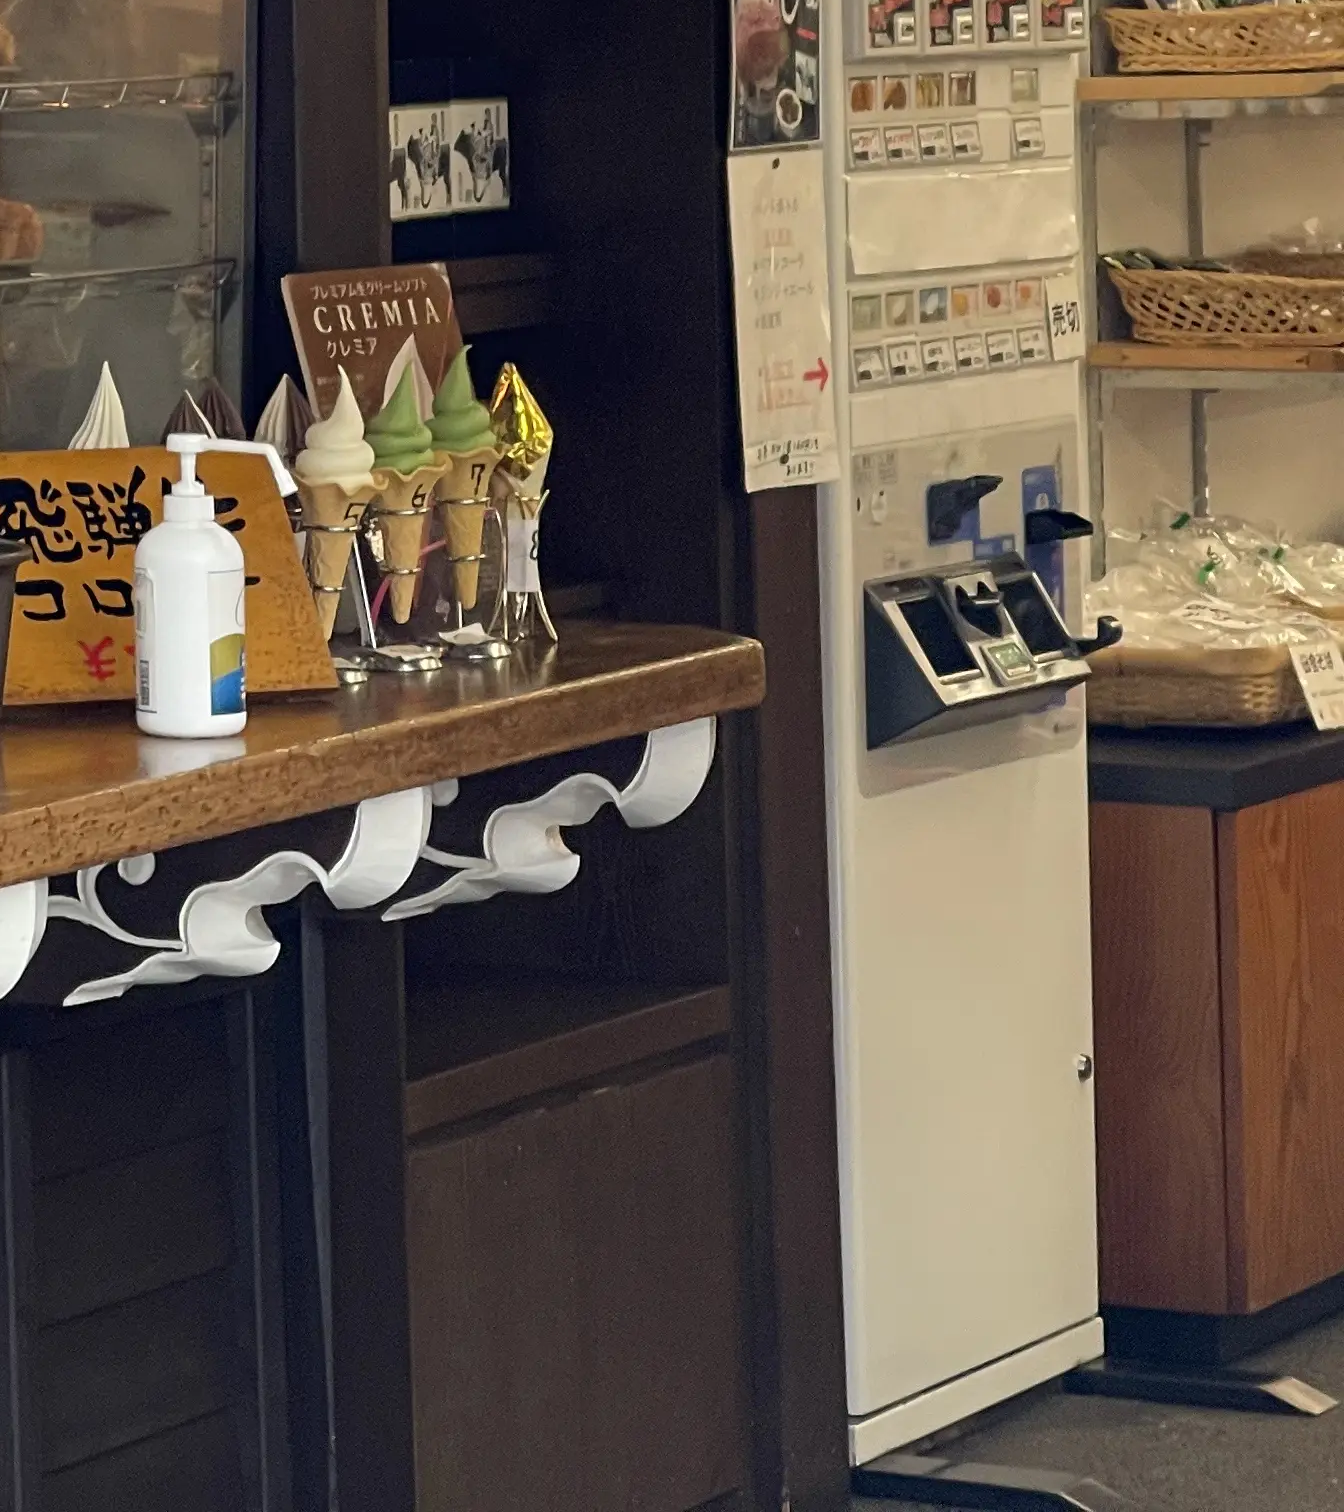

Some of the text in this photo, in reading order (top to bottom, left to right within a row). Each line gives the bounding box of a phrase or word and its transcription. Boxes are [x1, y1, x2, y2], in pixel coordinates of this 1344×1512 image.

[313, 296, 442, 334] CREMIA
[326, 337, 377, 359] クレミア
[470, 463, 486, 496] 7
[411, 483, 427, 508] 6
[344, 501, 367, 528] 5
